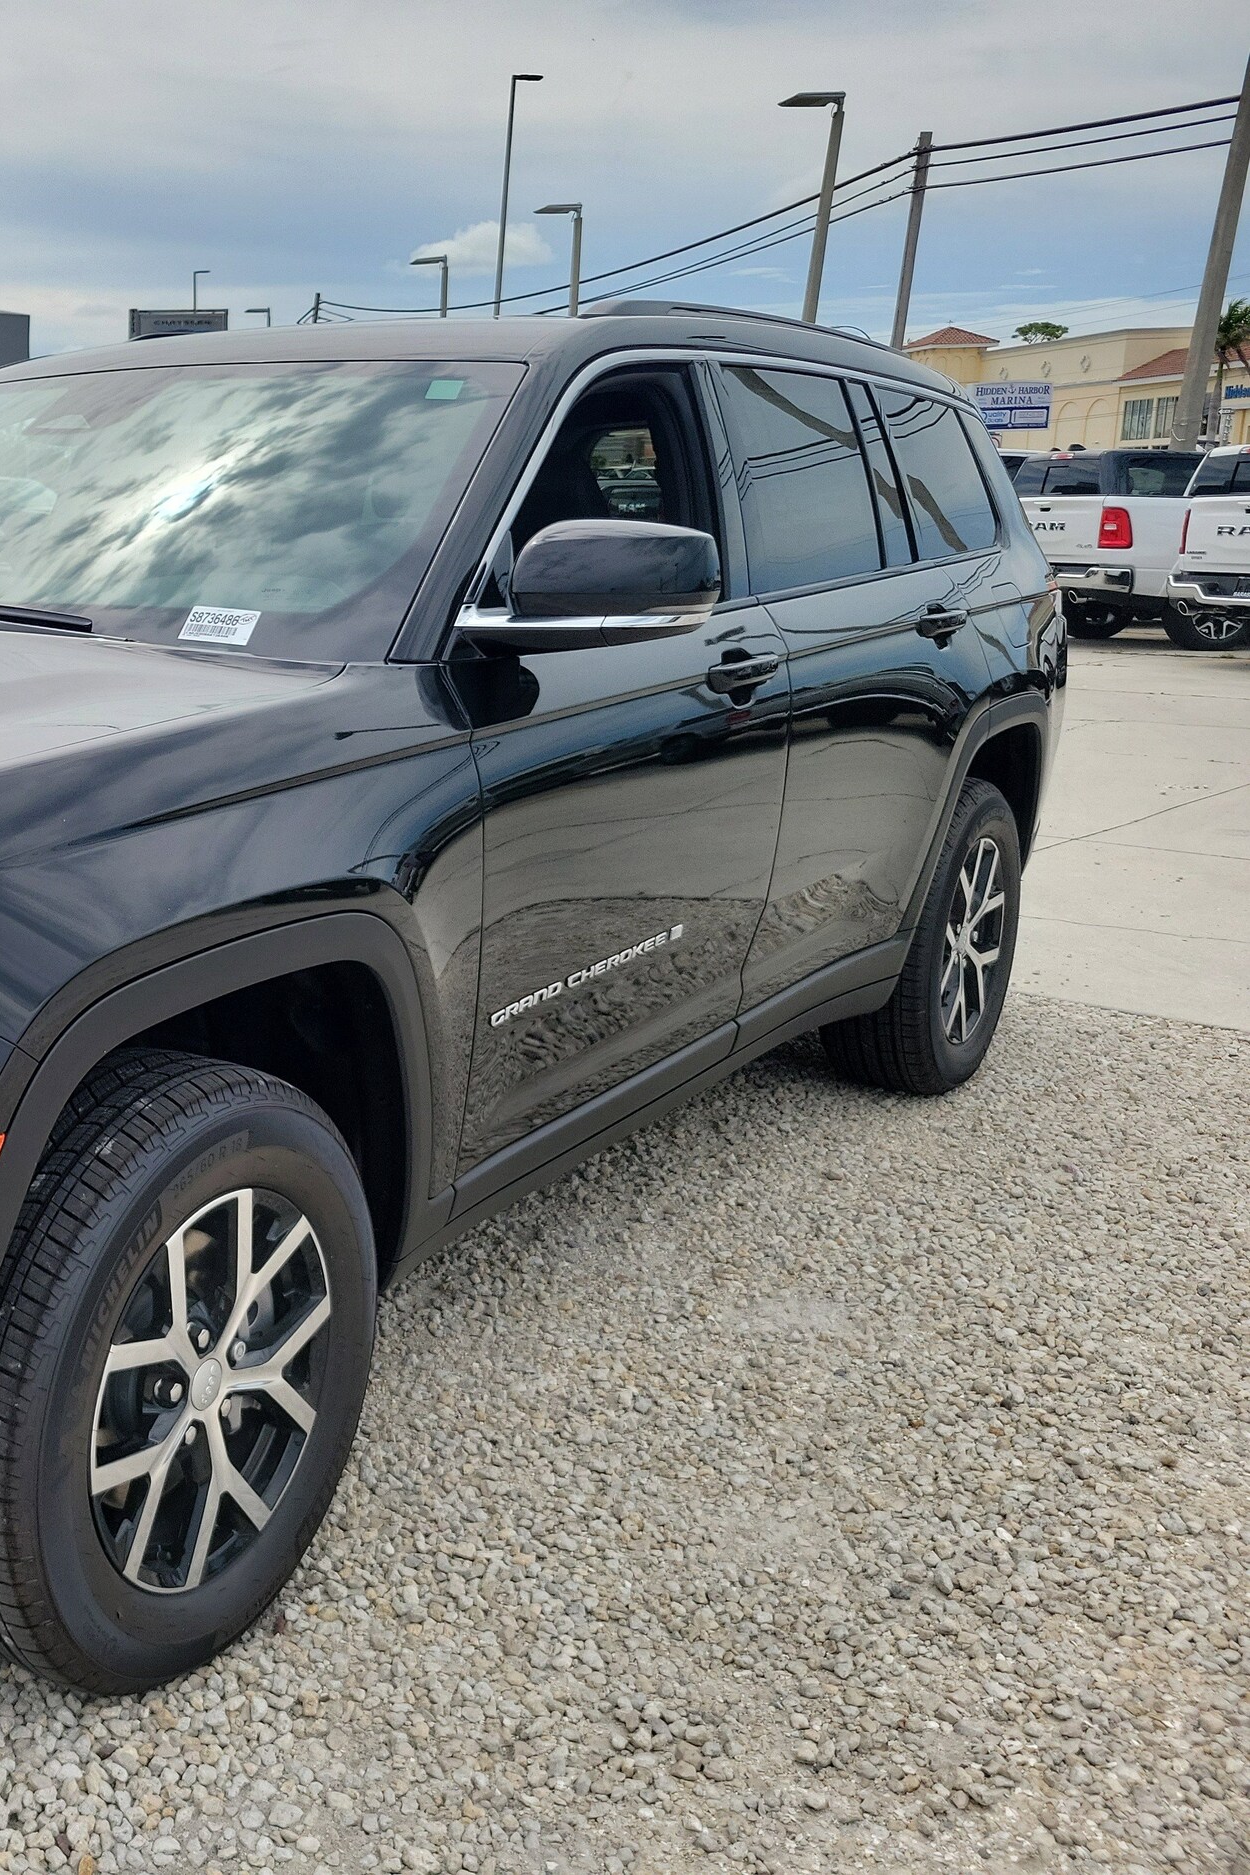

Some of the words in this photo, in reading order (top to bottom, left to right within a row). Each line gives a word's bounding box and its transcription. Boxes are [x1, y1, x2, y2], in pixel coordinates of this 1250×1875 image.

[976, 387, 1007, 396] HIDDEN
[1018, 385, 1050, 395] HARBOR
[1225, 384, 1250, 399] Hidde
[990, 396, 1033, 405] MARINA
[1030, 521, 1066, 531] AM
[1217, 525, 1250, 536] RA
[190, 611, 241, 626] S8736486
[490, 981, 562, 1027] GRAND
[565, 931, 667, 988] CHEROKEE
